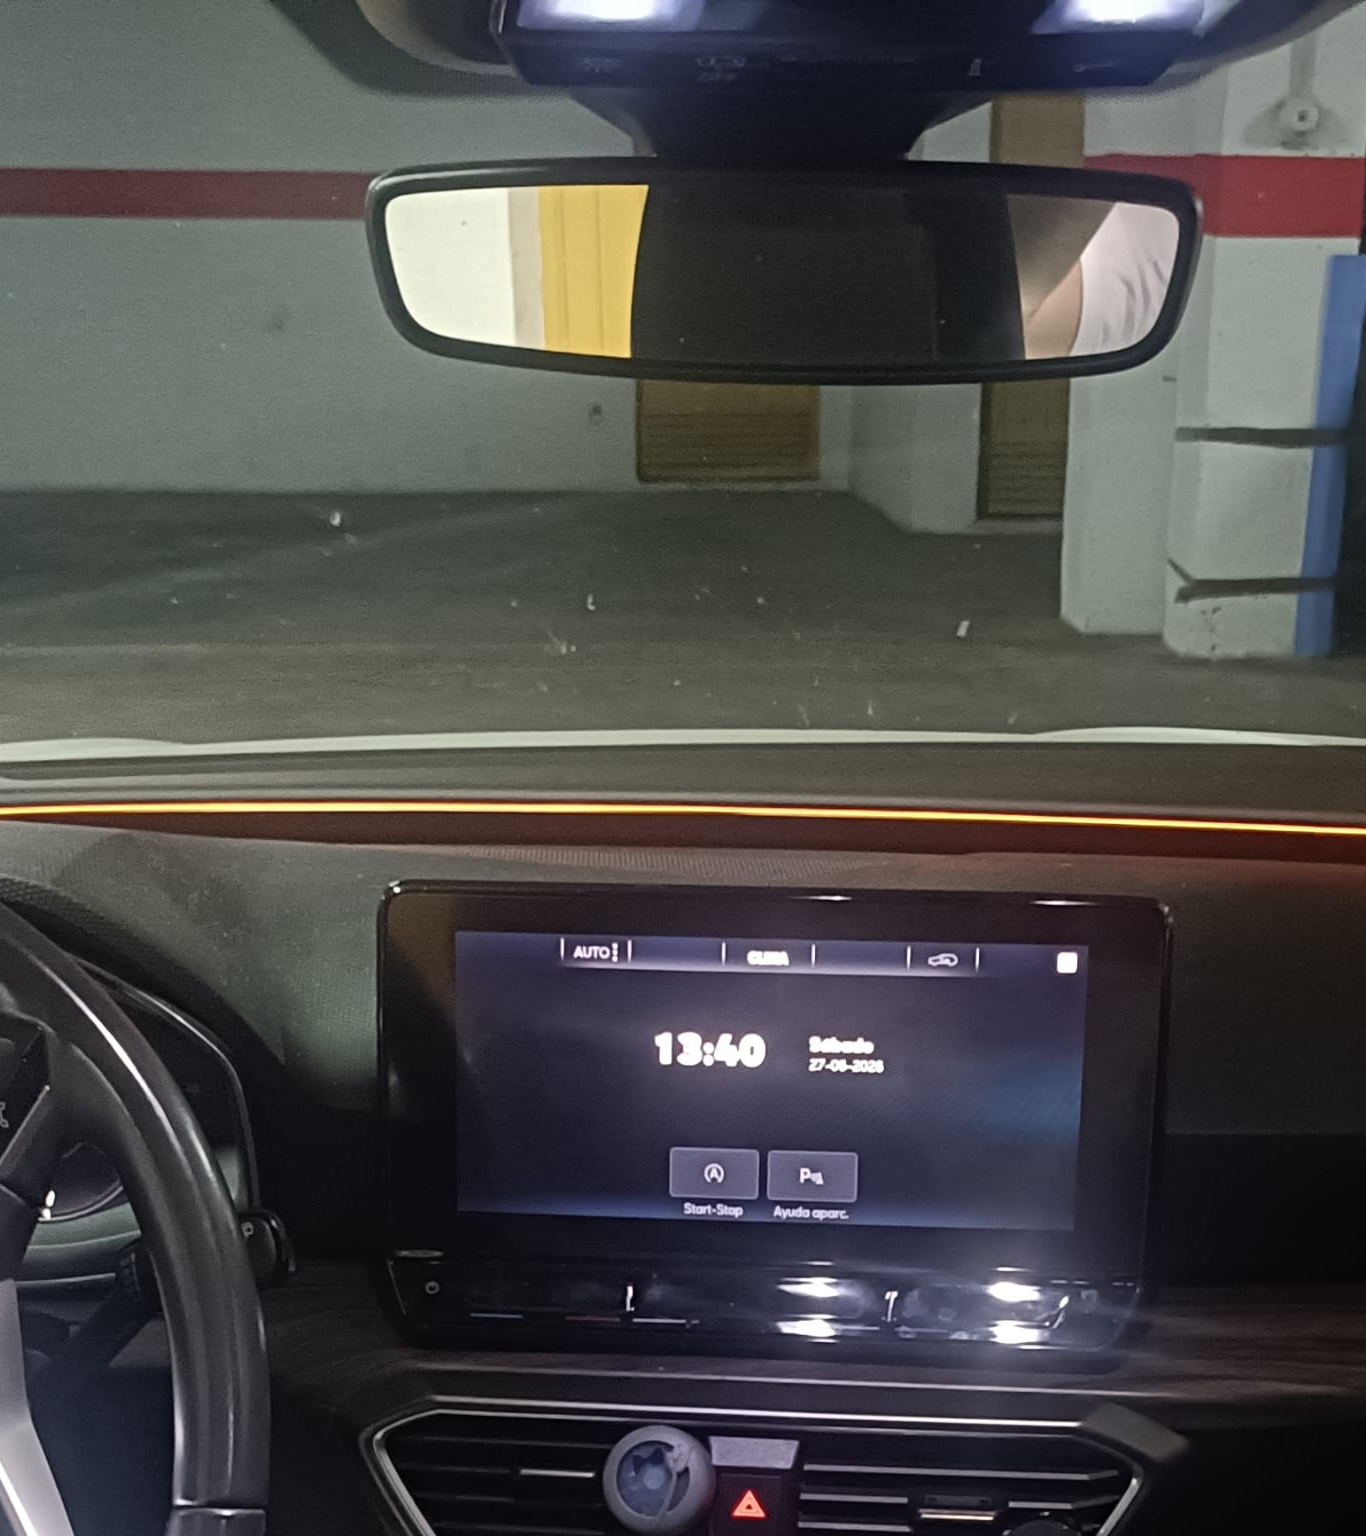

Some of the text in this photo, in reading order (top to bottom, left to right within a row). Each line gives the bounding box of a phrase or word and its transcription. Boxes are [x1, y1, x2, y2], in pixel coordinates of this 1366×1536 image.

[573, 945, 610, 959] AUTO
[654, 1032, 766, 1067] 13:40
[684, 1202, 744, 1218] Start-Stop
[773, 1205, 810, 1220] Ayuda
